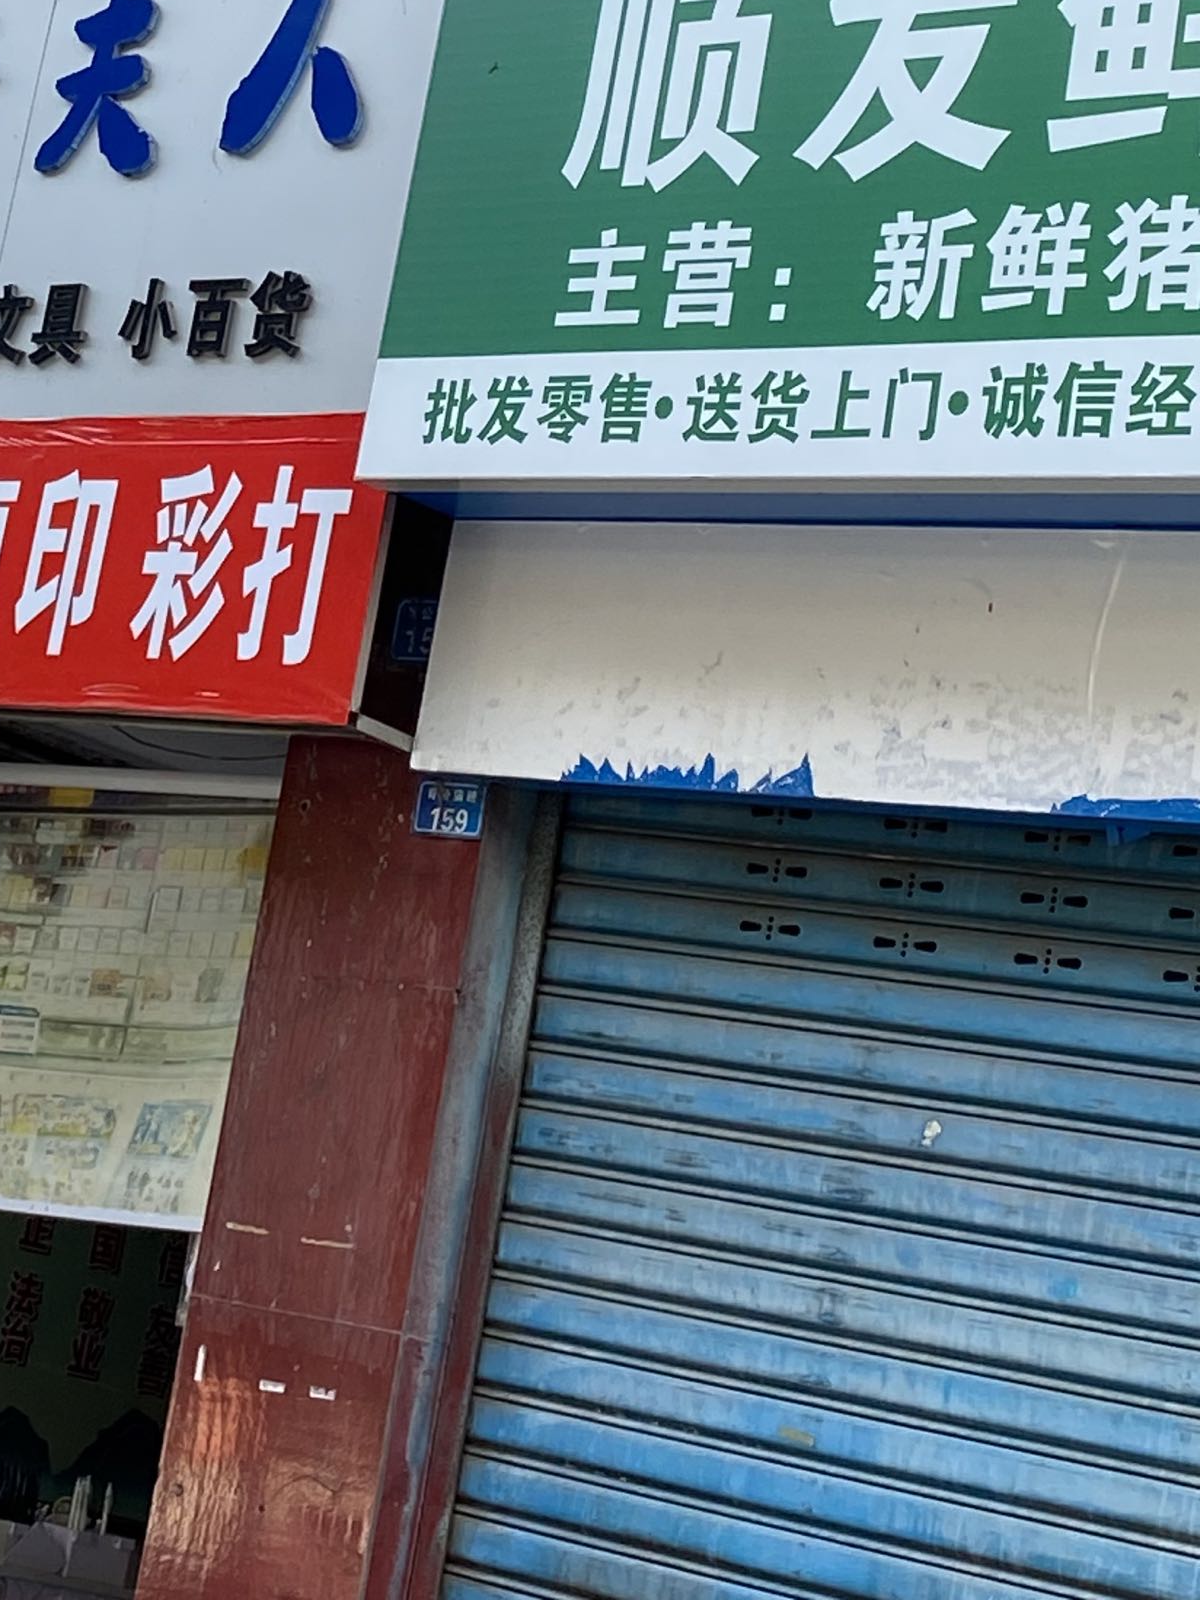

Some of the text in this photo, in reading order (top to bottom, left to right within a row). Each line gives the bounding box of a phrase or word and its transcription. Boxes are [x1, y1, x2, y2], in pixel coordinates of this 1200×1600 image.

[119, 271, 314, 361] 小百货
[129, 463, 354, 666] 彩打
[430, 807, 469, 833] 159
